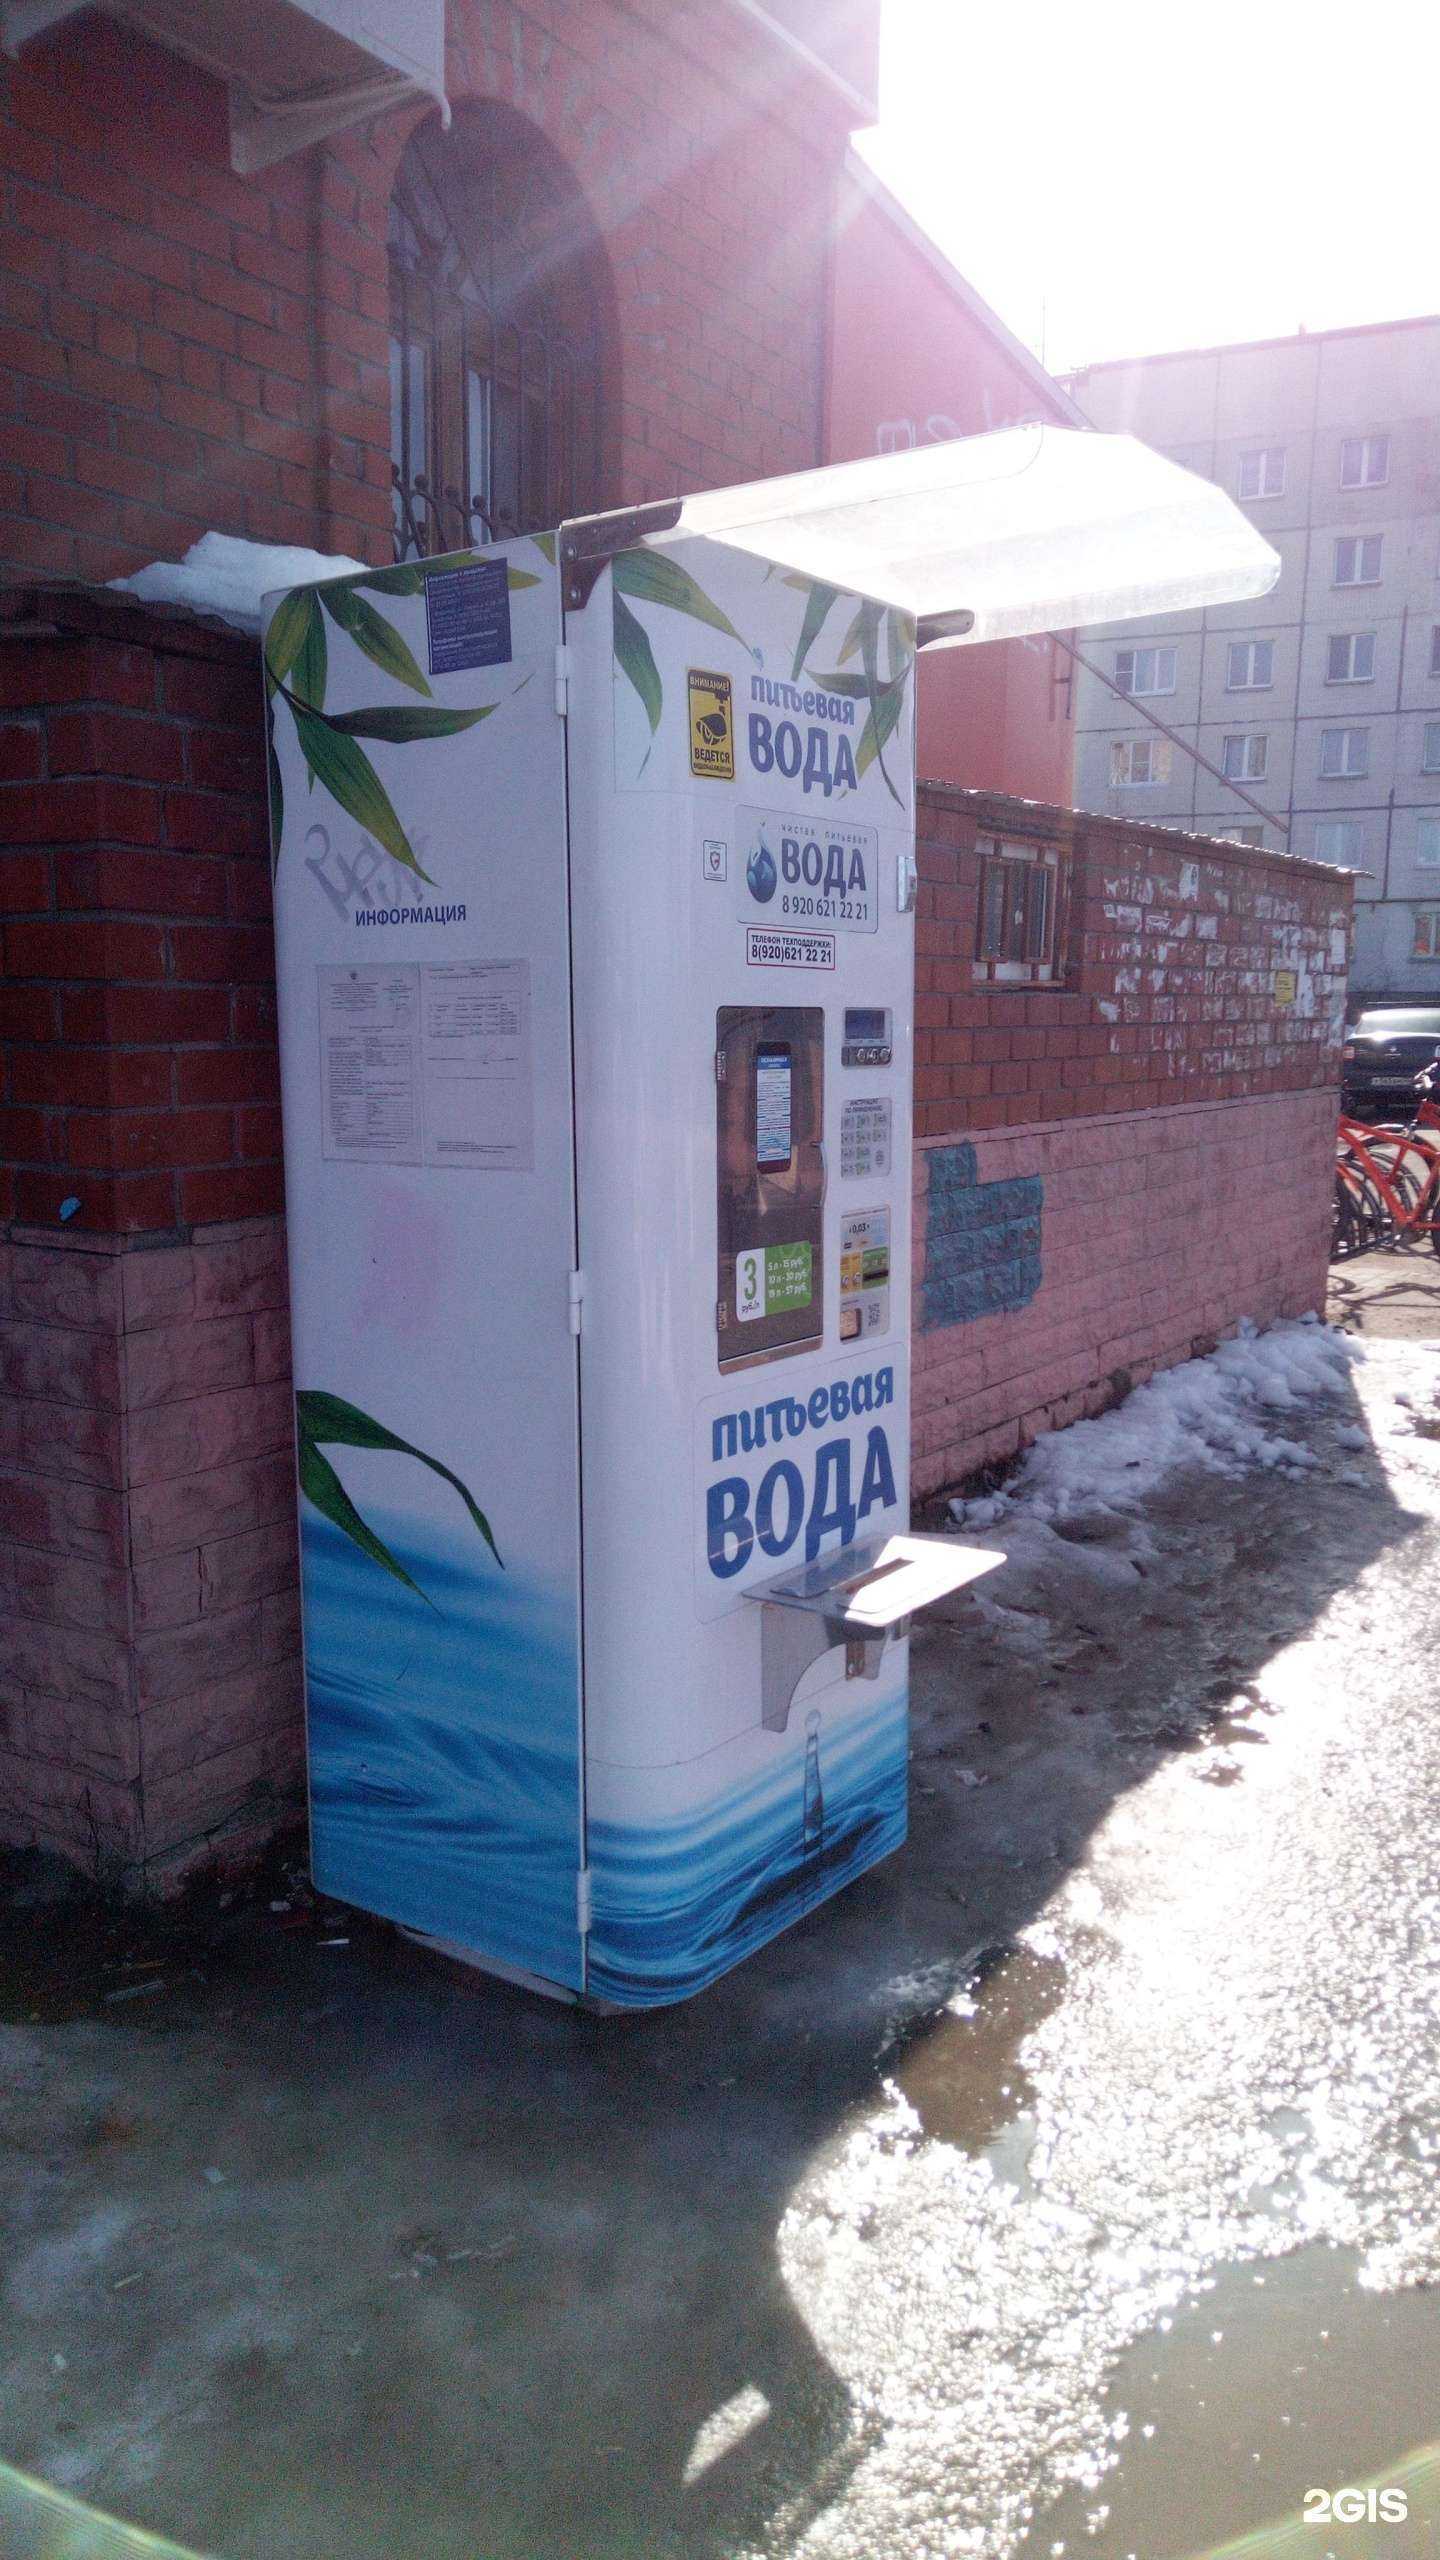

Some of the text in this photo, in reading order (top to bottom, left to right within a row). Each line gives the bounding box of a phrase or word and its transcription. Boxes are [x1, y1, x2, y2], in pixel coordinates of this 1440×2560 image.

[689, 676, 730, 692] ВНИМАНИЕ!
[751, 675, 855, 726] питьевая
[694, 747, 730, 764] ВЕДЕТСЯ
[748, 712, 858, 798] ВОДА
[781, 838, 867, 899] ВОДА
[355, 904, 467, 927] ИНФОРМАЦИЯ
[782, 895, 868, 921] 8 920 621 22 21
[751, 934, 781, 945] ТЕЛЕФОН
[751, 944, 832, 963] 8(920)621 22 21
[744, 1257, 757, 1301] 3
[712, 1366, 894, 1463] питьевая
[706, 1425, 898, 1580] ВОДА
